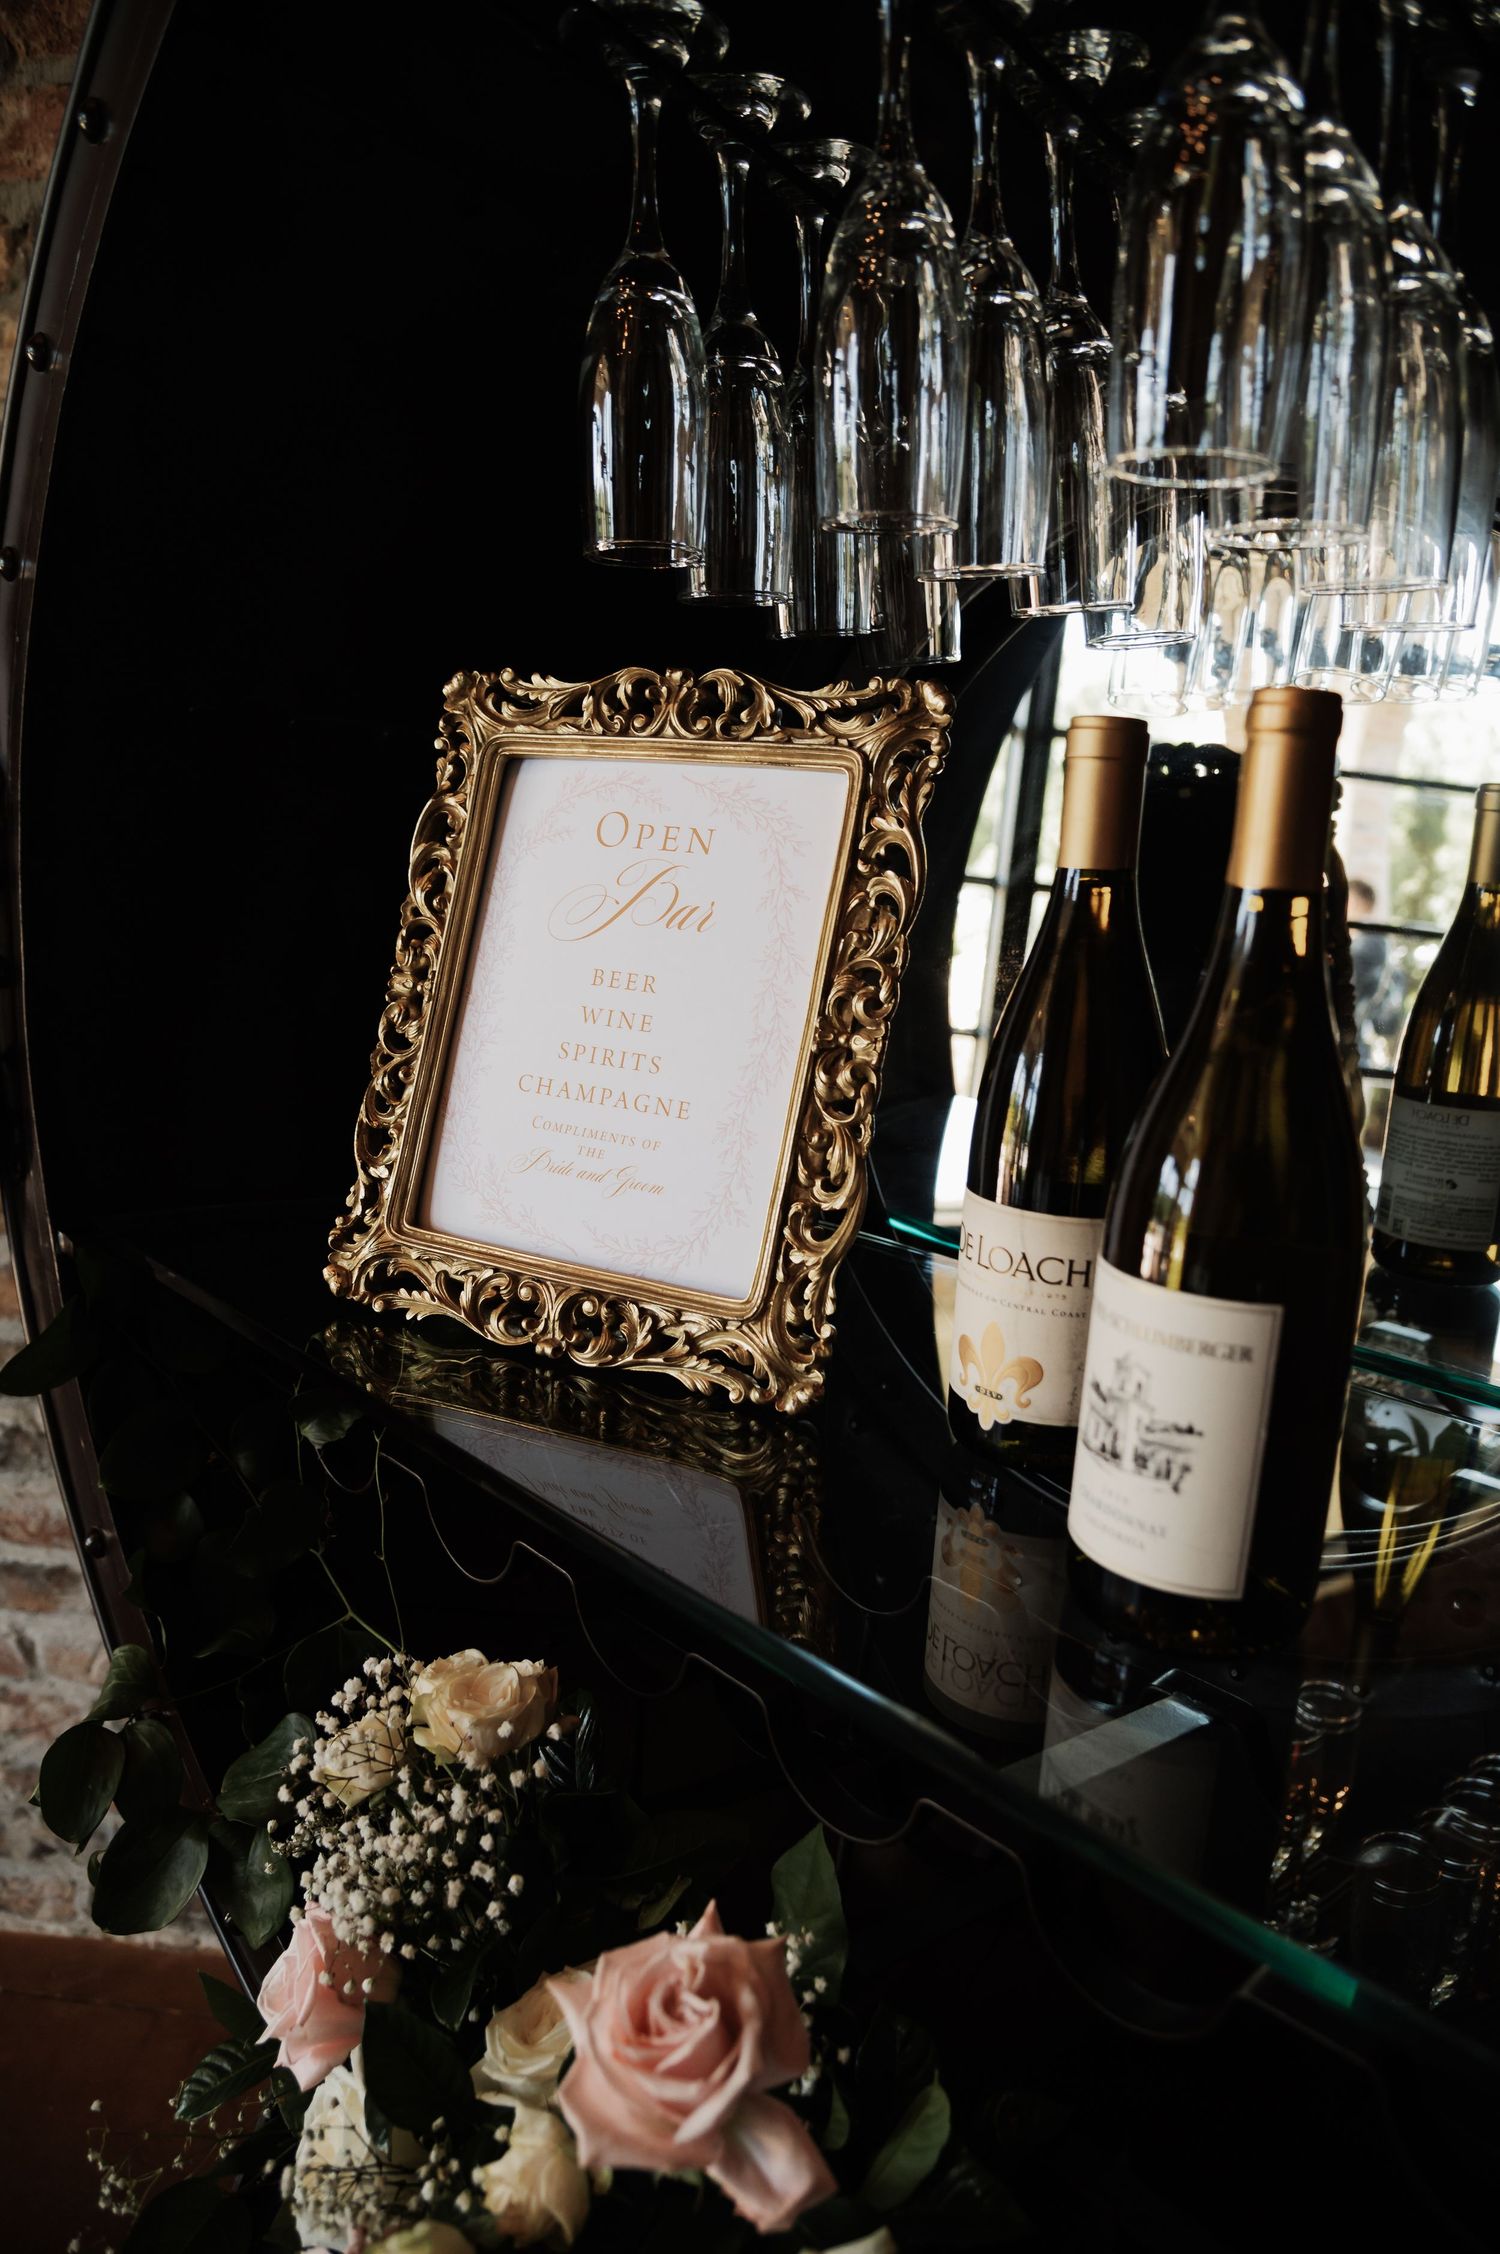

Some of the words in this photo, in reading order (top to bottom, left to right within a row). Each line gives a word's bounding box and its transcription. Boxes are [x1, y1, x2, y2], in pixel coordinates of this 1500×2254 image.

[596, 811, 716, 855] OPEN
[547, 858, 716, 942] Bar
[591, 968, 657, 993] BEER
[580, 1005, 654, 1033] WINE
[558, 1041, 663, 1074] SPIRITS
[518, 1073, 691, 1120] CHAMPAGNE
[531, 1115, 637, 1146] COMPLIMENTS
[641, 1139, 663, 1152] OF
[577, 1144, 606, 1160] THE
[507, 1147, 573, 1175] Bride
[576, 1167, 611, 1184] and
[601, 1164, 665, 1198] Groom
[977, 1234, 1092, 1288] LOACH
[999, 1298, 1047, 1316] CENTRAL
[1050, 1308, 1088, 1319] COAST
